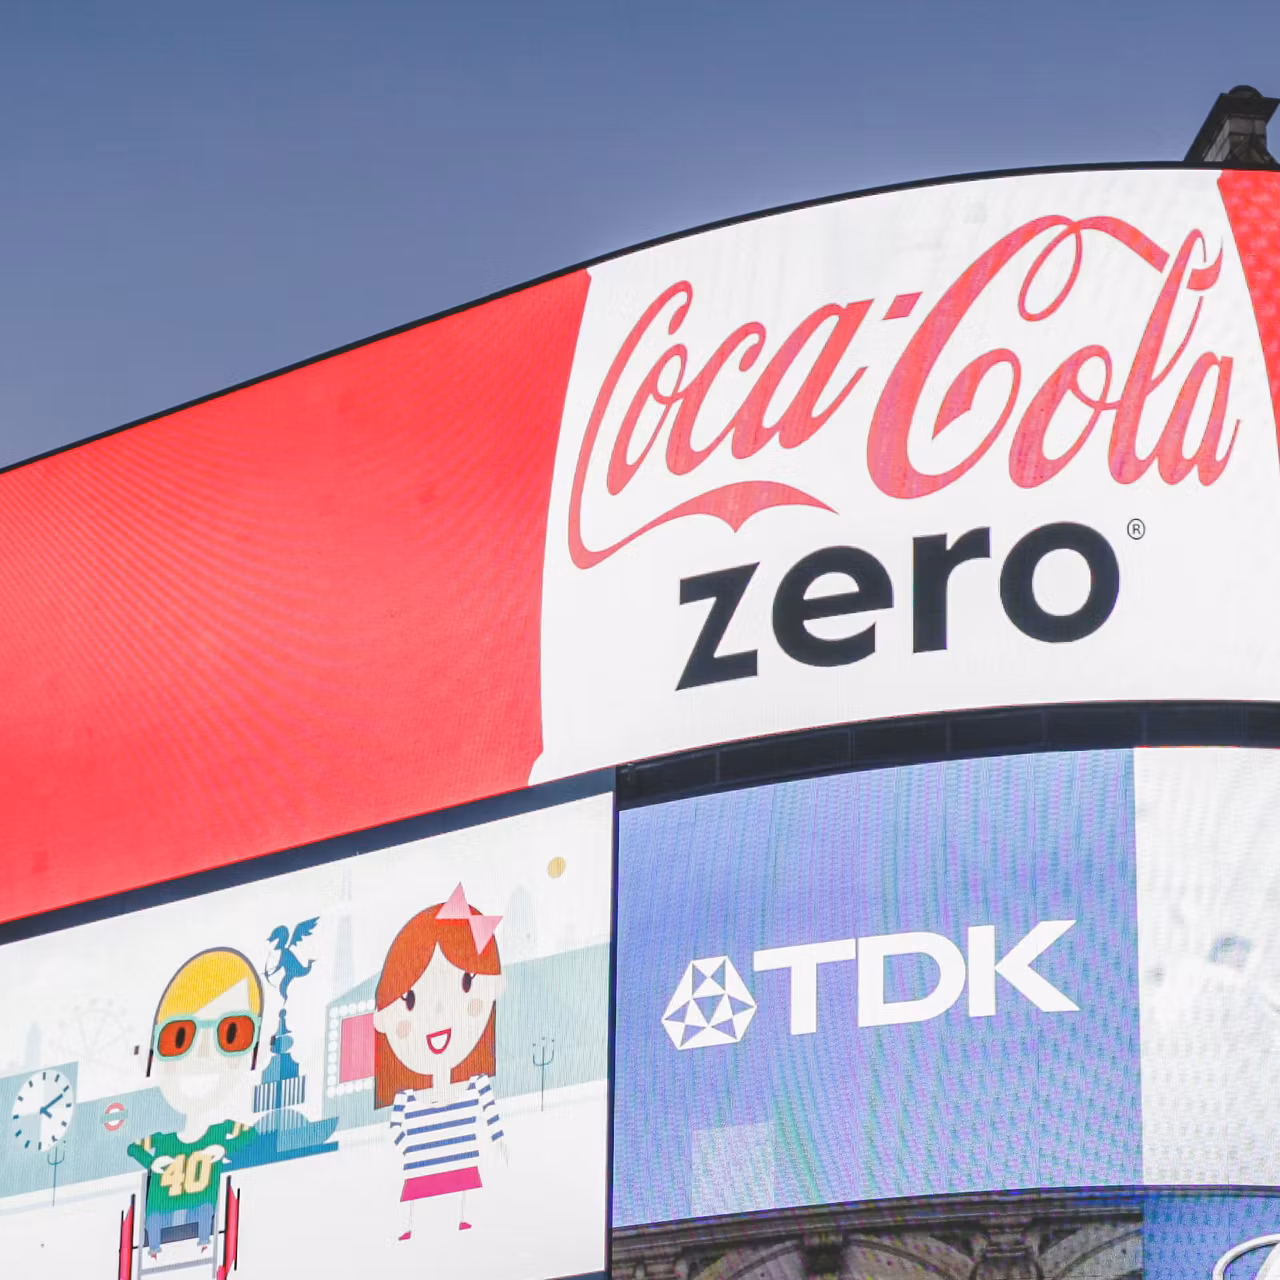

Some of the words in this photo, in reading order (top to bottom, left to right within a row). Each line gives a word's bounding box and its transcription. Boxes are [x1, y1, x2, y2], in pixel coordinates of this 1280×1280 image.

[568, 214, 1240, 569] Coca-Cola
[675, 520, 1120, 691] zero
[753, 919, 1080, 1035] TDK
[160, 1149, 214, 1197] 40
